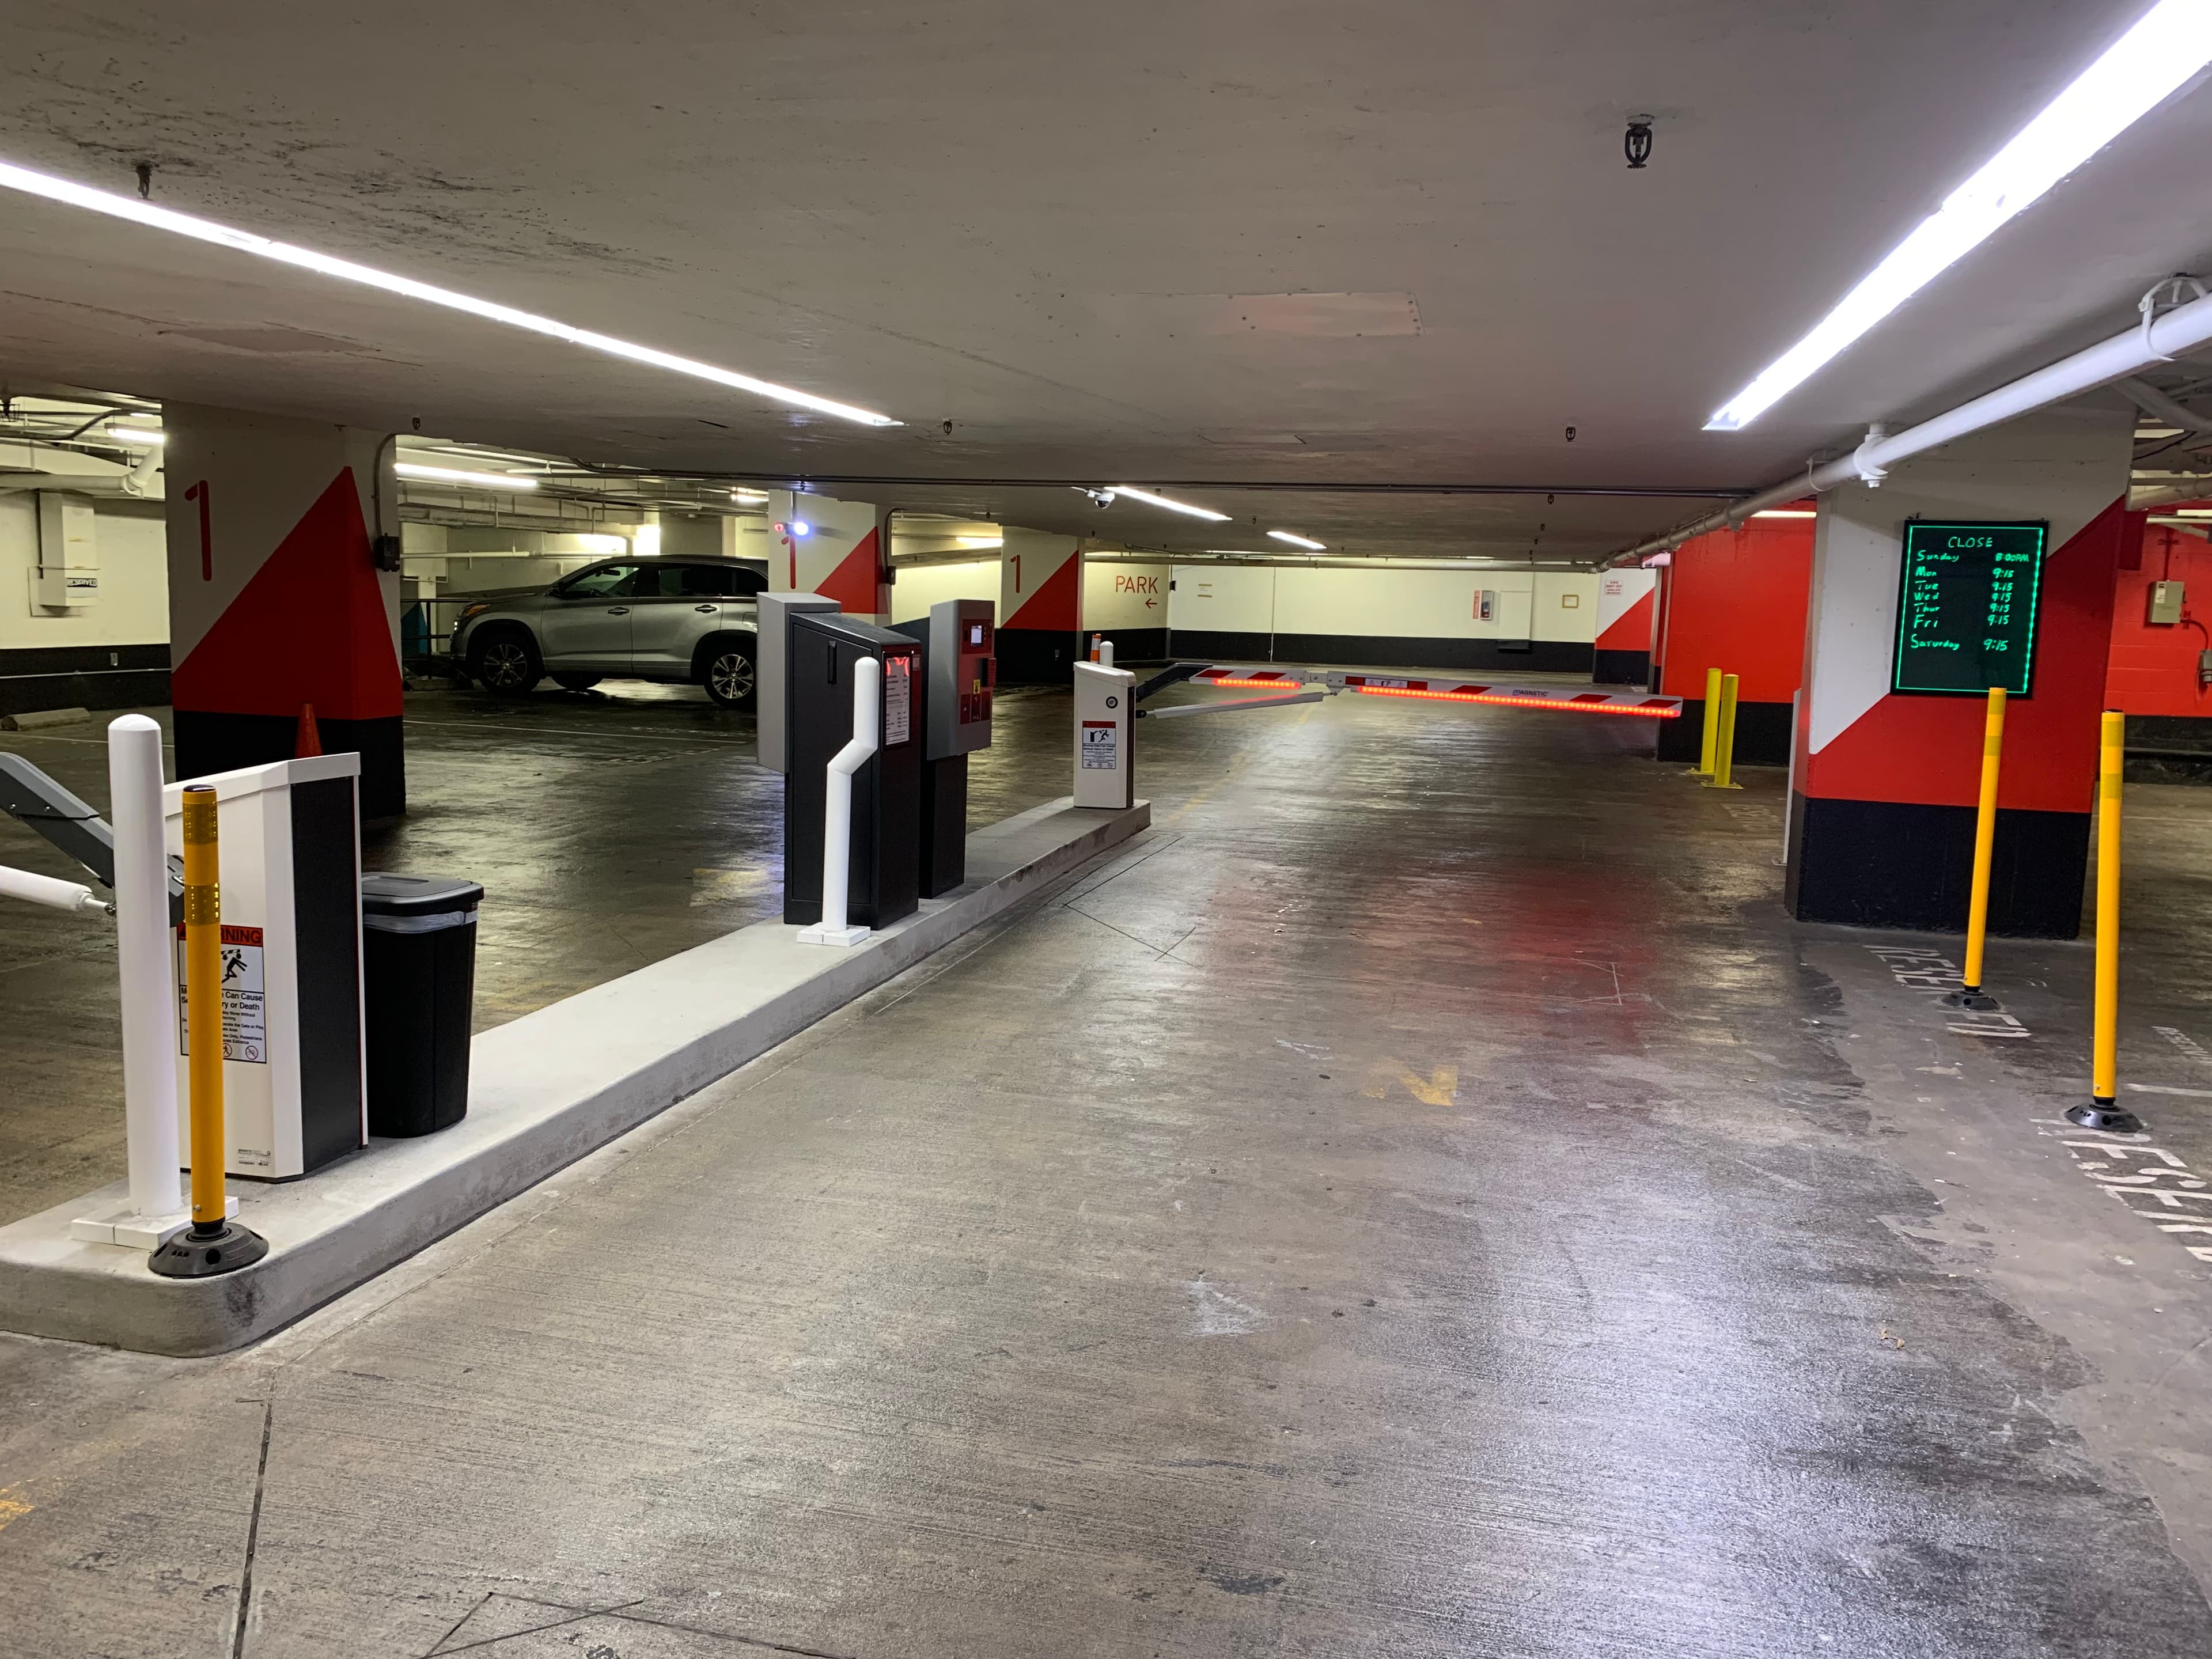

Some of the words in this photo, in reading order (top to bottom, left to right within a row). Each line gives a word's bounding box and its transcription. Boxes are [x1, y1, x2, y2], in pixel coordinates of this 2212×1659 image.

[184, 479, 212, 581] 1
[1948, 536, 1994, 548] CLOSE
[1916, 550, 1960, 562] Sunday
[1010, 554, 1020, 593] 1
[1915, 566, 1937, 577] Mon
[1992, 567, 2014, 578] 9:15
[1115, 575, 1158, 594] PARK
[1914, 580, 1939, 590] Tue
[1914, 592, 1940, 601] Wed
[1991, 592, 2013, 603] 9:15
[1914, 602, 1941, 612] Thur
[1989, 603, 2010, 613] 9:15
[1914, 614, 1939, 628] Fri
[1987, 614, 2010, 627] 9:15
[1910, 633, 1960, 651] Saturday
[1983, 638, 2009, 652] 9:15
[221, 928, 262, 944] NING
[1862, 944, 2032, 1037] RESERED
[241, 993, 263, 1001] Cause
[240, 1002, 260, 1010] Death
